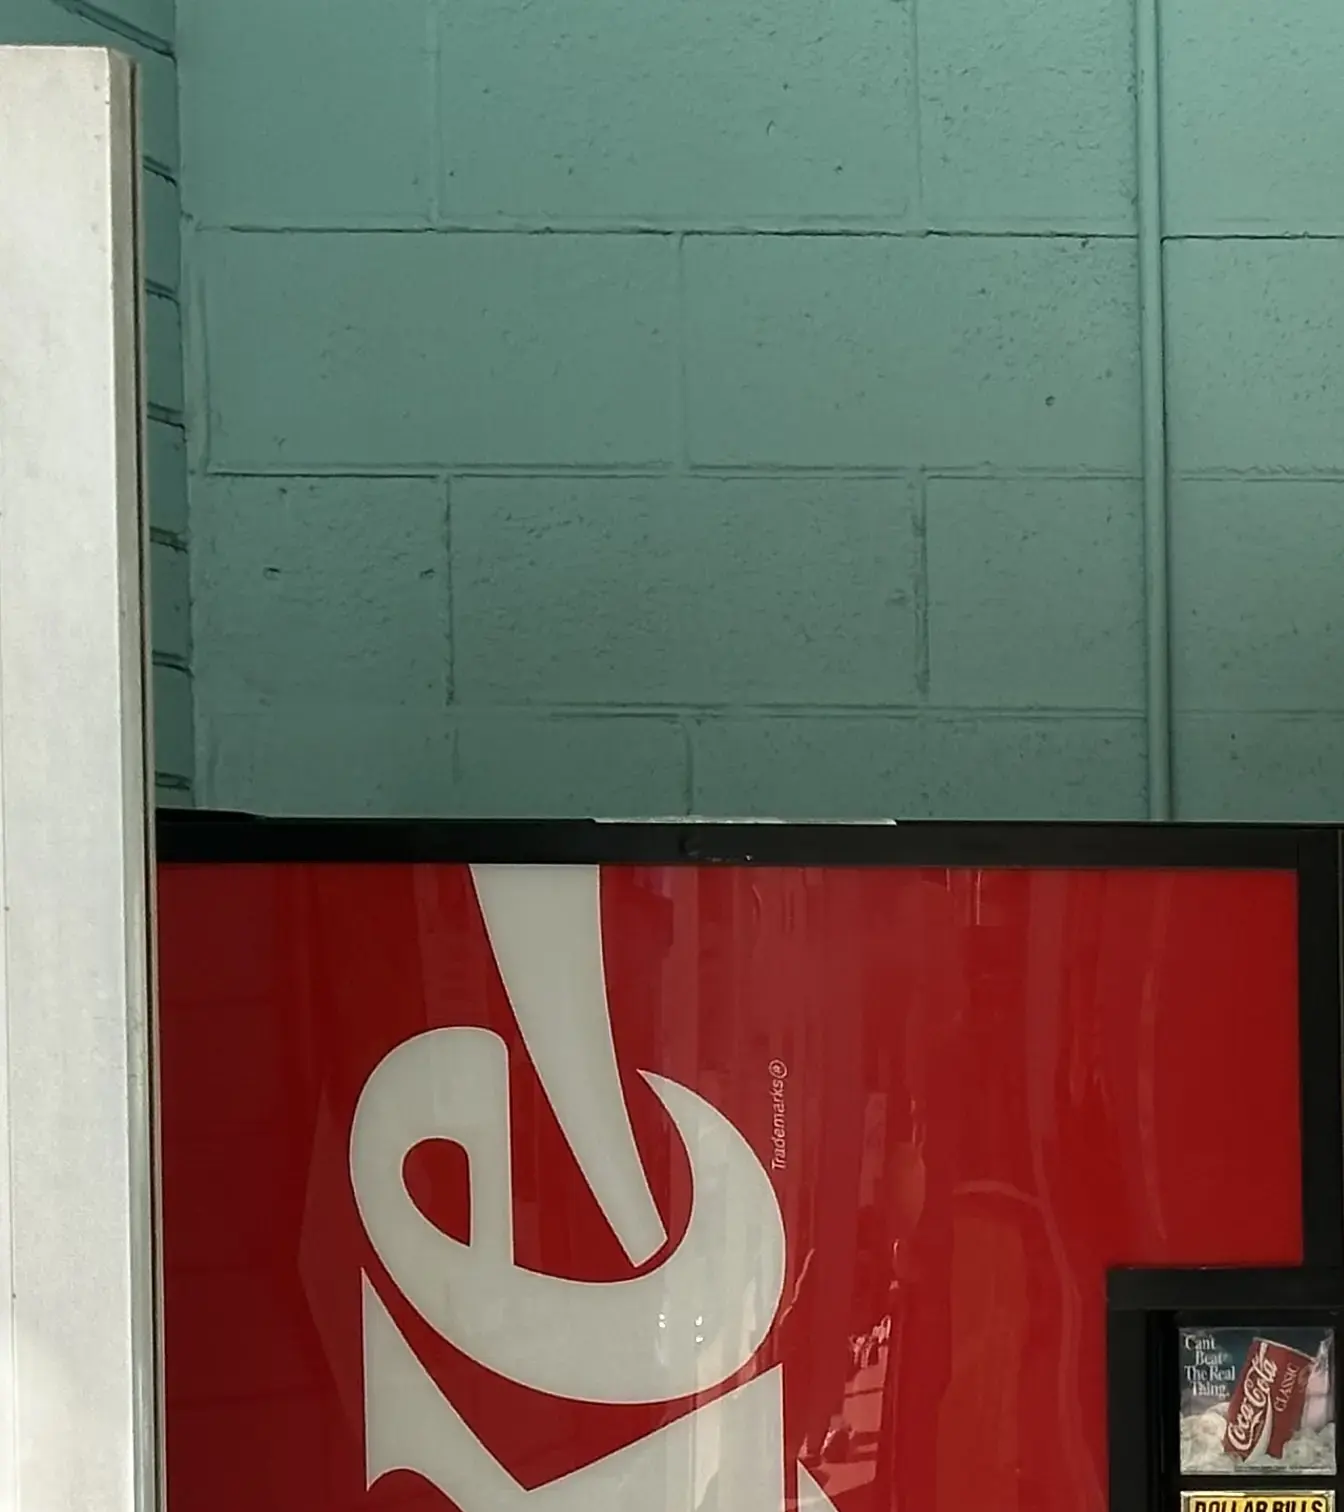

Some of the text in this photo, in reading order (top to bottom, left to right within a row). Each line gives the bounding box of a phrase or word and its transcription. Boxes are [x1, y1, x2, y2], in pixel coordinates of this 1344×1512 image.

[1184, 1366, 1236, 1381] The Real
[1191, 1381, 1230, 1398] Thing.
[1273, 1361, 1300, 1413] CLASSIC
